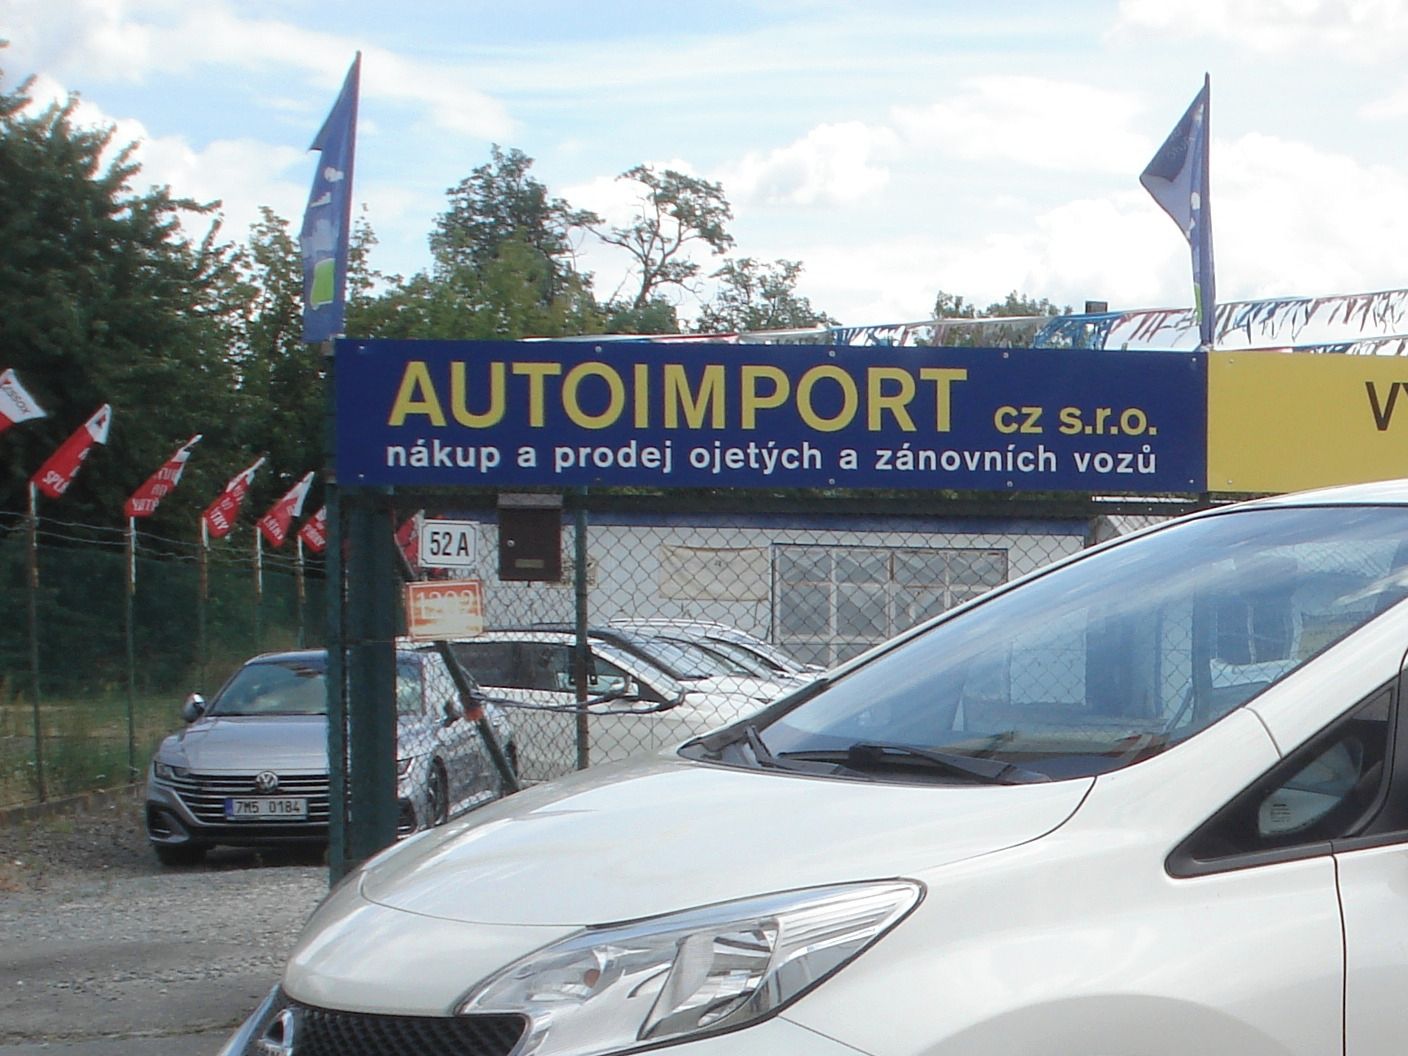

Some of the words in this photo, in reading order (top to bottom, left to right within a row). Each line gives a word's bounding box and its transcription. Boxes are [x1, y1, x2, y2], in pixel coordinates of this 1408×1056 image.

[387, 361, 968, 433] AUTOIMPORT
[993, 405, 1044, 435] cz
[1057, 406, 1159, 436] s.r.o.
[386, 438, 501, 474] nákup
[517, 445, 537, 468] a
[554, 439, 673, 474] prodej
[689, 440, 822, 475] ojetých
[838, 447, 858, 470] a
[874, 443, 1057, 473] zánovních
[1073, 443, 1156, 475] vozů
[430, 531, 453, 557] 52
[456, 531, 470, 557] A
